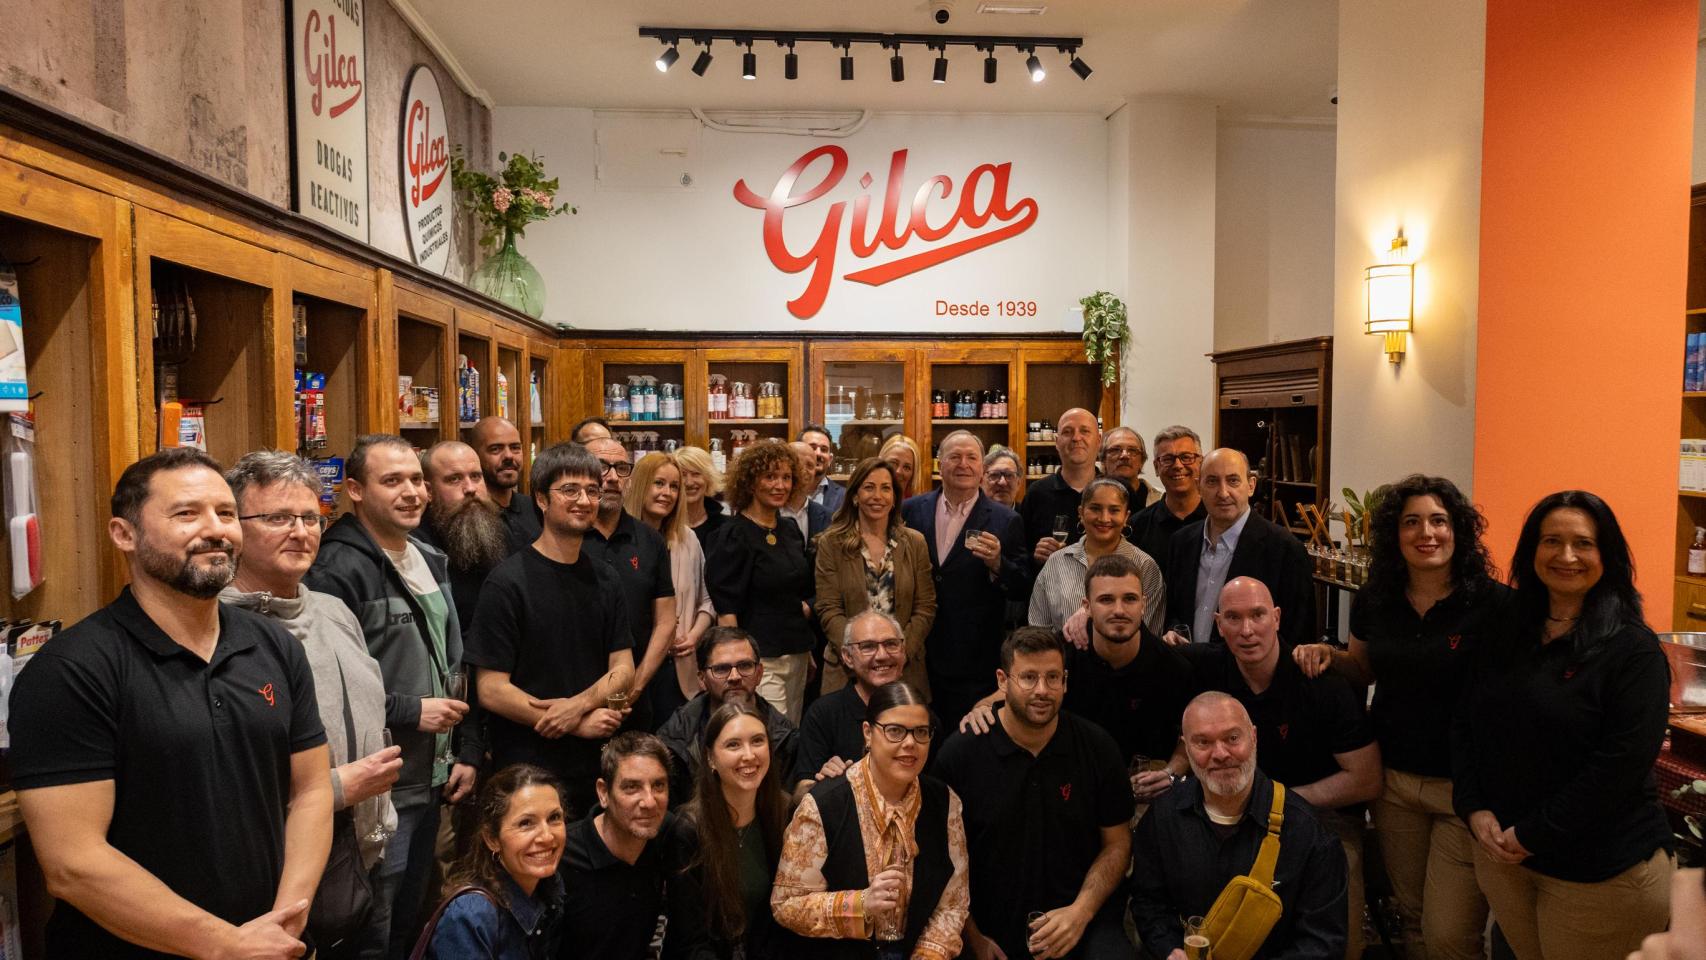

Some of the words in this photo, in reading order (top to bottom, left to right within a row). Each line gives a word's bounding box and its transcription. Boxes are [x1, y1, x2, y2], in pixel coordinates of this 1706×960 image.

[304, 9, 362, 119] Gilca
[317, 139, 353, 183] DROGAS
[407, 99, 449, 208] Gilca
[311, 180, 359, 227] REACTIVOS
[418, 204, 443, 231] PRODUCTOS
[420, 231, 449, 264] INDUSTRIALES
[733, 144, 1039, 320] Gilca
[935, 300, 990, 317] Desde
[996, 301, 1038, 317] 1939
[20, 634, 49, 649] Pattex
